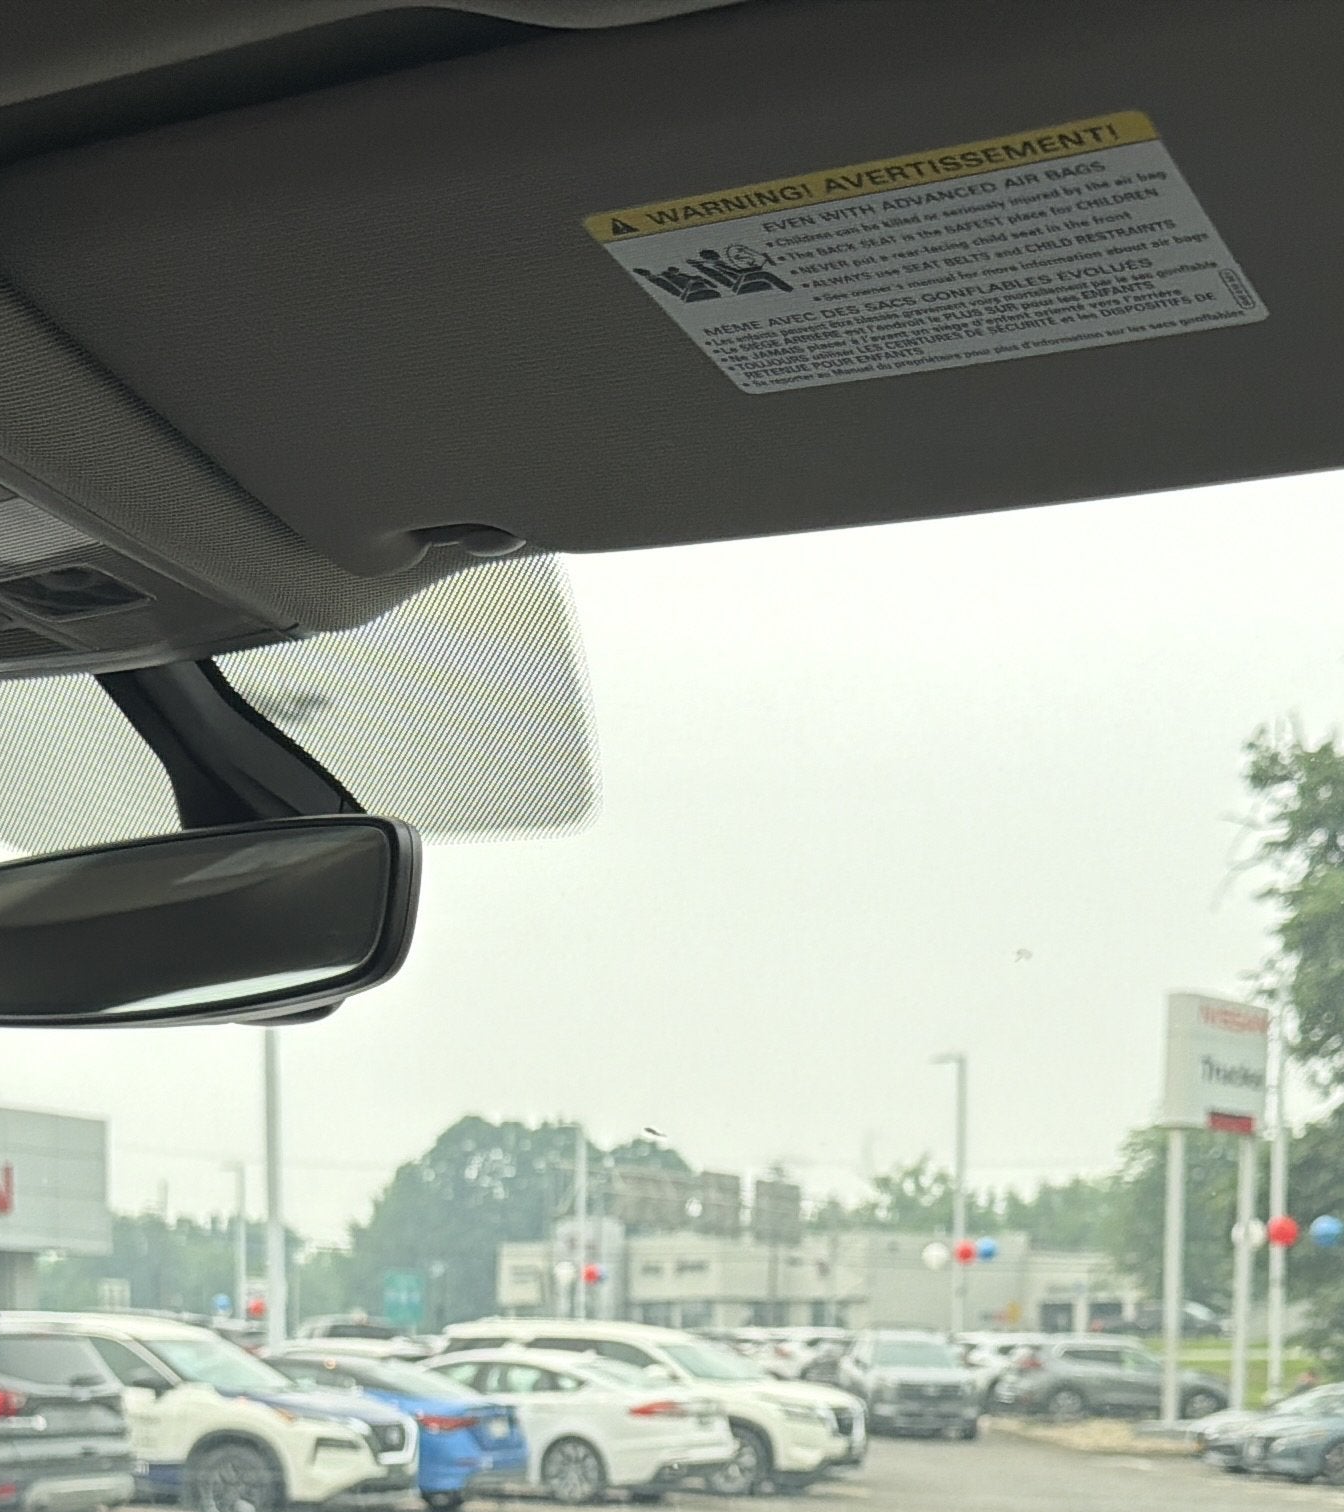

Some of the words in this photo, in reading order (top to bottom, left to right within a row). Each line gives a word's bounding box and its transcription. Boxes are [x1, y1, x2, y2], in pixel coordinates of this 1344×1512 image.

[646, 184, 812, 224] WARNING!
[826, 125, 1117, 192] AVERTISSEMENT!
[762, 215, 816, 232] EVEN
[818, 204, 876, 221] WITH
[883, 182, 997, 210] ADVANCED
[1004, 174, 1040, 189] AIR
[1044, 161, 1105, 180] BAGS
[775, 232, 833, 246] Children
[860, 223, 880, 232] be
[881, 214, 921, 228] killed
[942, 201, 1005, 217] seriously
[1008, 189, 1060, 206] injured
[1060, 186, 1082, 196] by
[1084, 181, 1110, 191] the
[1136, 171, 1167, 182] bag
[787, 251, 814, 261] The
[816, 243, 857, 256] BACK
[860, 235, 896, 248] SEAT
[916, 229, 942, 238] the
[944, 216, 1002, 233] SAFEST
[1007, 210, 1047, 224] place
[1049, 205, 1072, 215] for
[1076, 188, 1158, 210] CHILDREN
[798, 260, 849, 274] NEVER
[852, 256, 877, 267] put
[892, 241, 969, 259] rear-facing
[972, 233, 1008, 246] child
[1010, 227, 1044, 239] seat
[1063, 220, 1090, 230] the
[1092, 211, 1132, 224] front
[813, 272, 872, 288] ALWAYS
[902, 260, 940, 273] SEAT
[942, 252, 990, 266] BELTS
[995, 247, 1023, 258] and
[1024, 238, 1072, 253] CHILD
[1075, 220, 1175, 244] RESTRAINTS
[1019, 251, 1102, 269] information
[1106, 243, 1148, 255] about
[768, 312, 817, 327] AVEC
[820, 305, 860, 318] DES
[863, 296, 917, 312] SACS
[921, 275, 1052, 302] GONFLABLES
